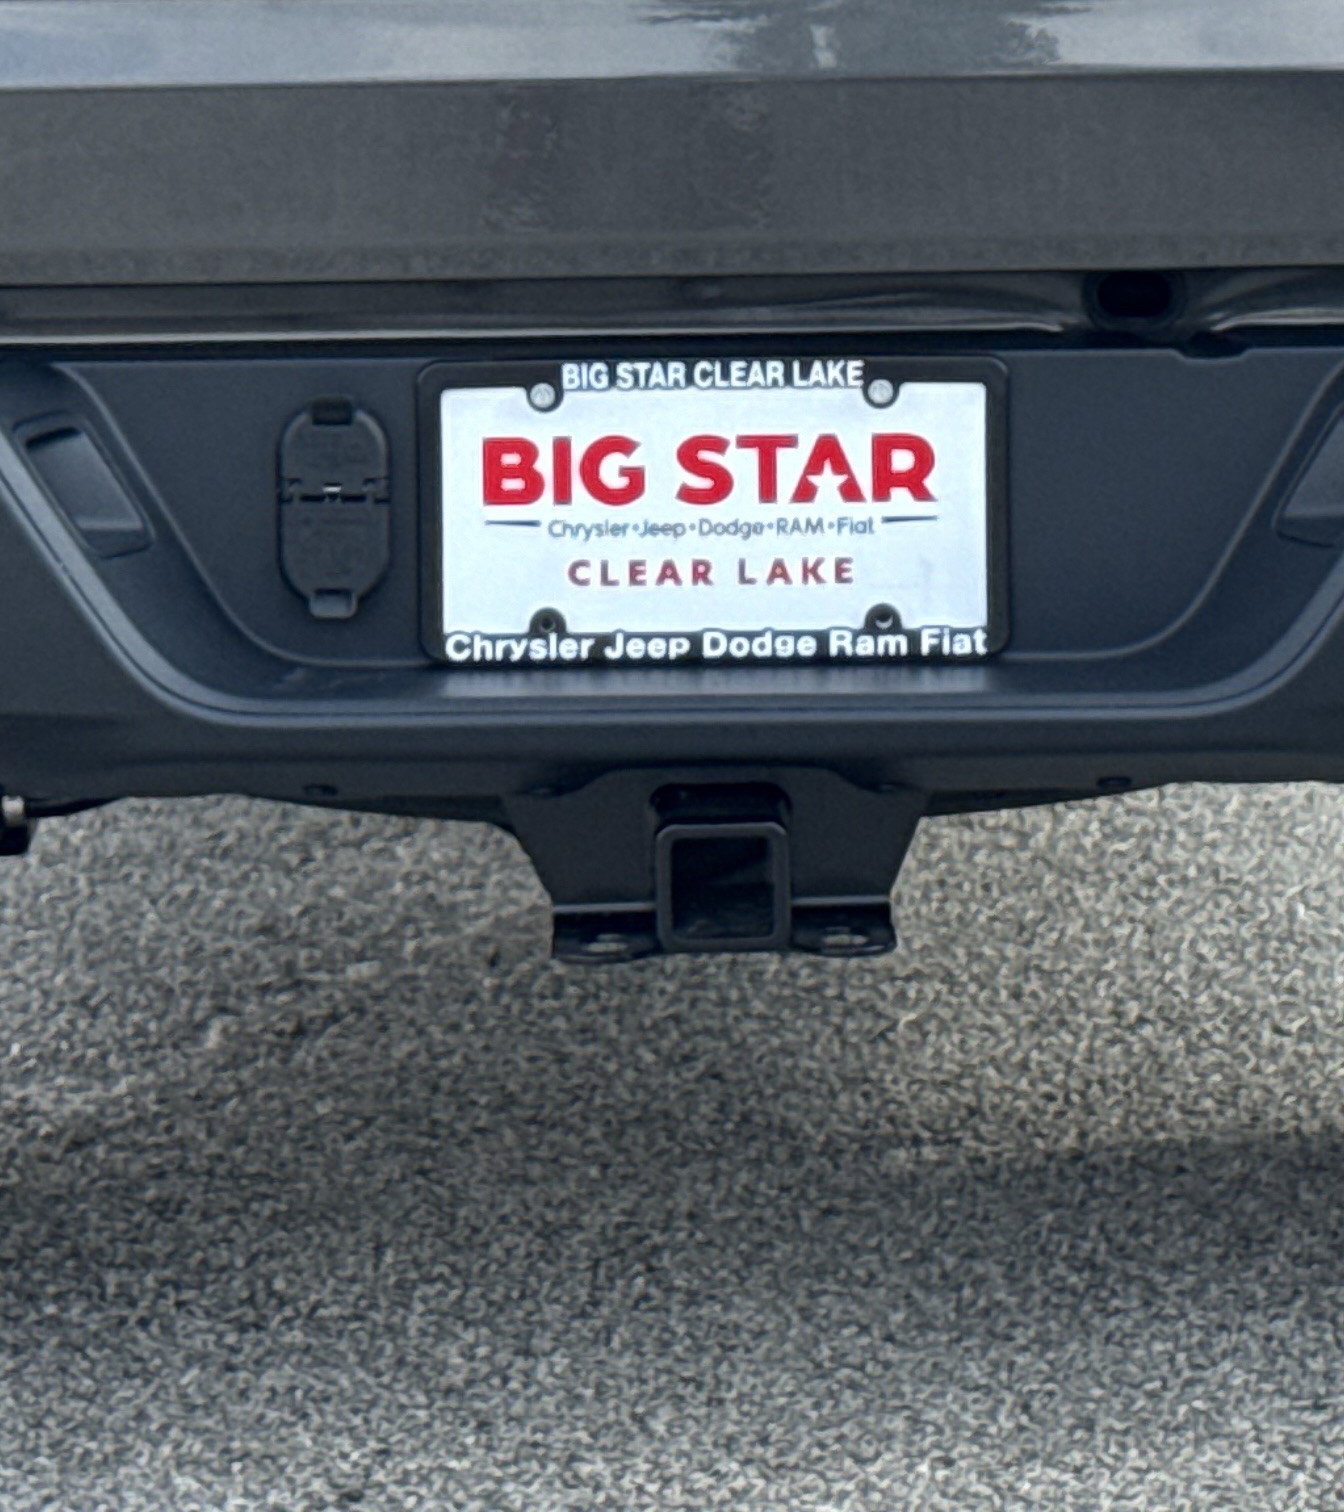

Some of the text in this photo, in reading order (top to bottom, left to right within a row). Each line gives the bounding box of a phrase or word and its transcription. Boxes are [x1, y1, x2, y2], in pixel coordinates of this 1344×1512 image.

[561, 360, 864, 389] BIG STAR CLEAR LAKE
[482, 433, 938, 506] BIG STAR
[547, 519, 629, 542] Chrysler
[640, 519, 686, 541] Jeep
[567, 557, 854, 586] CLEAR LAKE
[444, 627, 988, 662] Chrysler Jeep Dodge Ram Fiat
